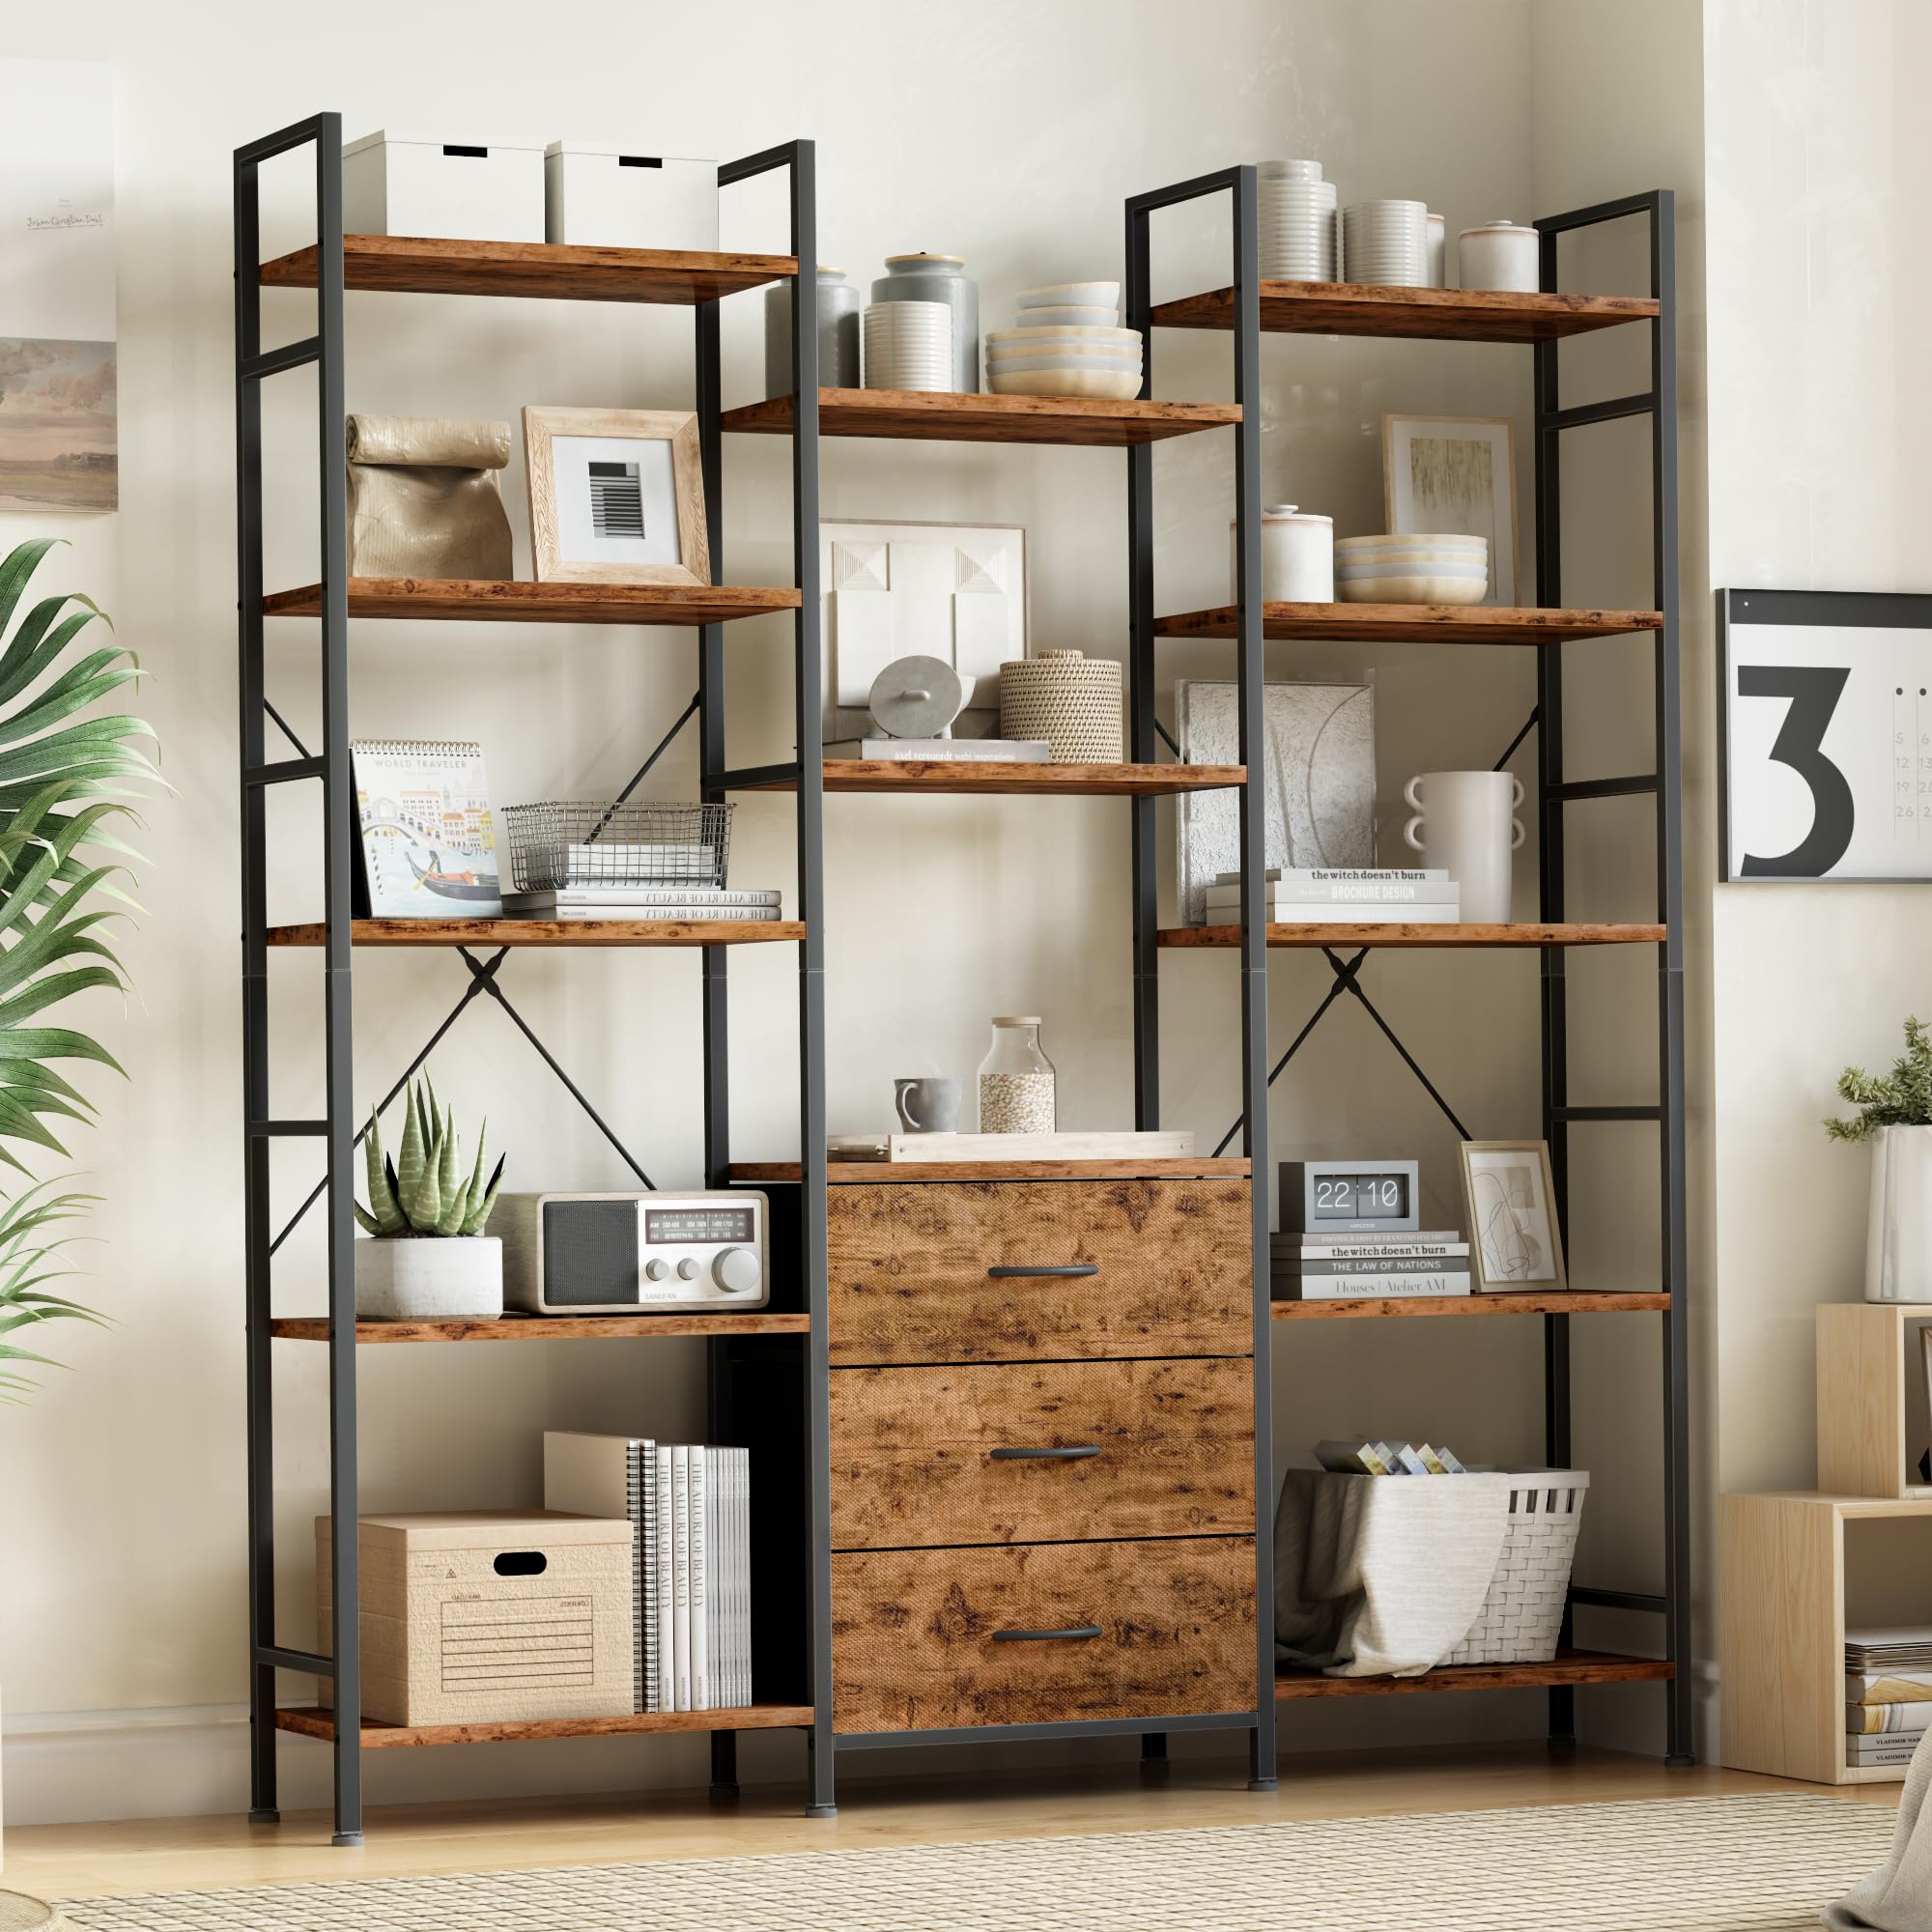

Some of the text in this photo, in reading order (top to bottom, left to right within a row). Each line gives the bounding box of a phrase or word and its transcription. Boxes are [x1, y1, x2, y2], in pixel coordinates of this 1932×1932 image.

[375, 759, 467, 769] WORLD TRAVELER
[1895, 756, 1910, 769] 12
[1738, 666, 1855, 877] 3
[1896, 781, 1910, 792] 19
[1895, 805, 1914, 817] 26
[1312, 870, 1329, 880] the
[1330, 869, 1359, 880] witch
[1401, 869, 1426, 880] burn
[1331, 886, 1380, 899] BROCHURE
[1382, 886, 1415, 899] DESIGN
[1317, 1180, 1398, 1208] 22 10
[1332, 1247, 1350, 1257] the
[1350, 1247, 1380, 1256] witch
[1421, 1245, 1446, 1255] burn
[1332, 1261, 1442, 1271] THE LAW OF NATIONS
[1336, 1278, 1446, 1293] Houses Atelier AM
